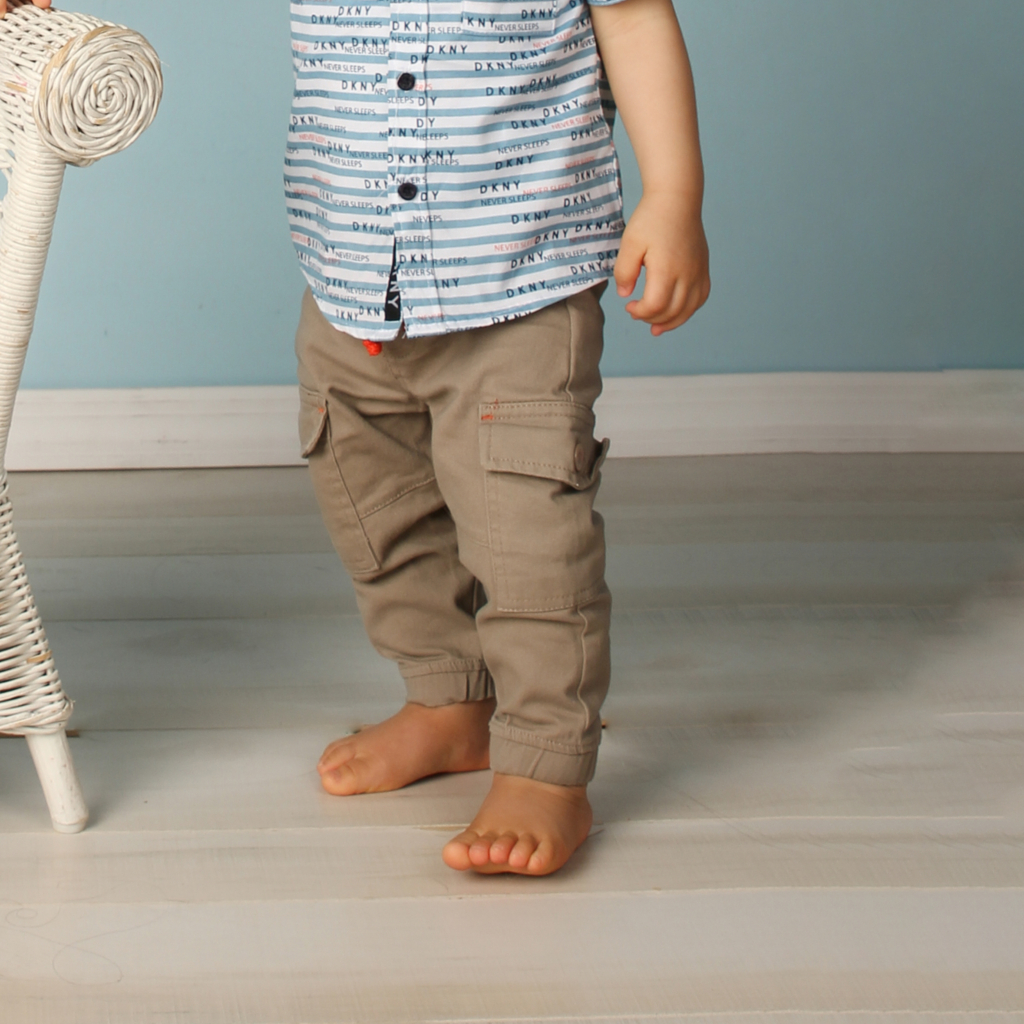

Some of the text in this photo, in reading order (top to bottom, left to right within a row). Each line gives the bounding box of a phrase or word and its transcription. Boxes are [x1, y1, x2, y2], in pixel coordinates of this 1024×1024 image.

[338, 6, 371, 16] DKNY
[522, 9, 553, 20] DKNY
[311, 15, 339, 24] DKNY
[336, 20, 355, 28] NEVER
[314, 41, 345, 50] DKNY
[352, 37, 388, 49] DKNY
[427, 45, 467, 54] DKNY
[510, 48, 547, 61] DKNY
[343, 64, 365, 73] SLEEPS
[475, 62, 514, 72] DKNY
[514, 62, 536, 71] NEVER
[376, 73, 382, 82] D
[342, 80, 376, 91] DKNY
[486, 86, 524, 96] DKNY
[335, 106, 376, 116] NEVER SLEEPS
[543, 99, 579, 118] DKNY
[511, 119, 546, 129] DKNY
[552, 118, 574, 130] NEVER
[498, 139, 550, 154] NEVER SLEEPS
[341, 159, 362, 167] SLEEPS
[495, 154, 534, 170] DKNY
[480, 180, 521, 194] DKNY
[481, 195, 536, 206] NEVER SLEEPS
[564, 192, 591, 208] DKNY
[511, 211, 550, 224] DKNY
[575, 218, 611, 233] DKNY
[535, 230, 568, 244] DKNY
[494, 241, 519, 252] NEVER
[510, 251, 544, 269] DKNY
[544, 253, 566, 262] NEVER
[570, 262, 602, 275] DKNY
[442, 278, 459, 288] NY
[546, 281, 570, 291] NEVER
[506, 280, 546, 298] DKNY
